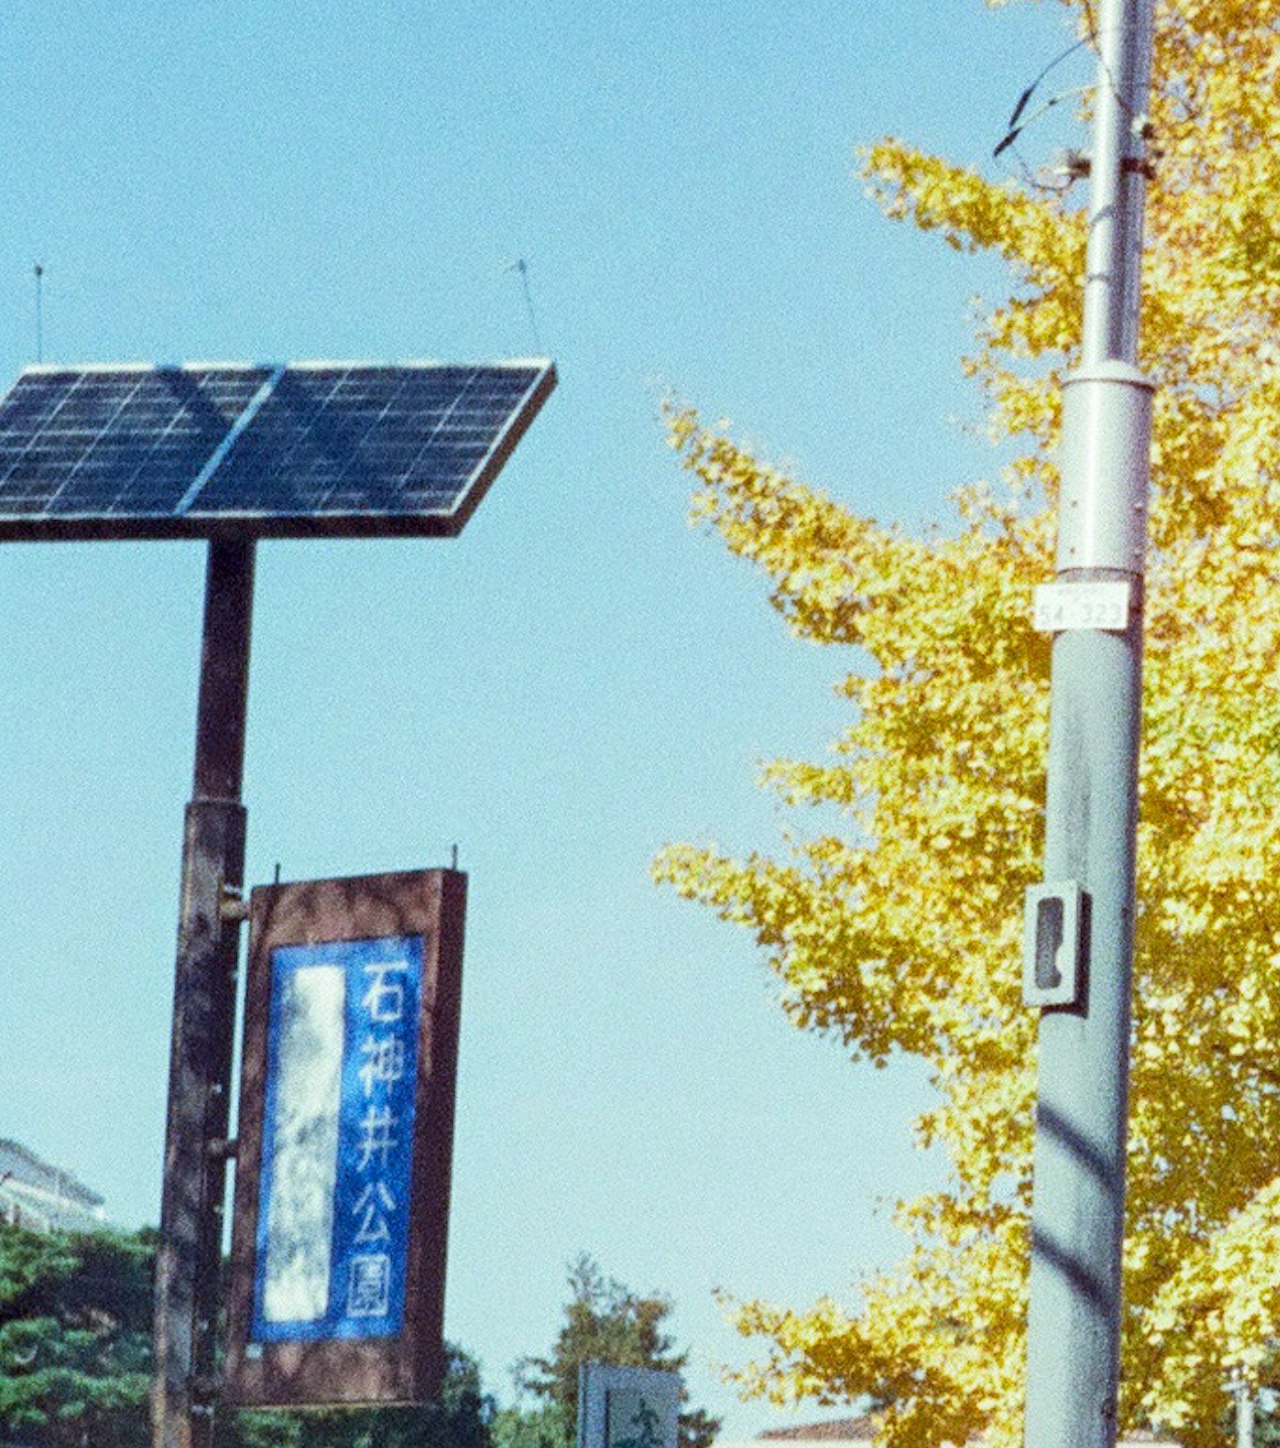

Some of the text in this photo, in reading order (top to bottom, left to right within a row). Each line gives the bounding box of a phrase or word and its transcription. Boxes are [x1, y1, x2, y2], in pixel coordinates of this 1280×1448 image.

[347, 960, 409, 1318] 石神井公園
